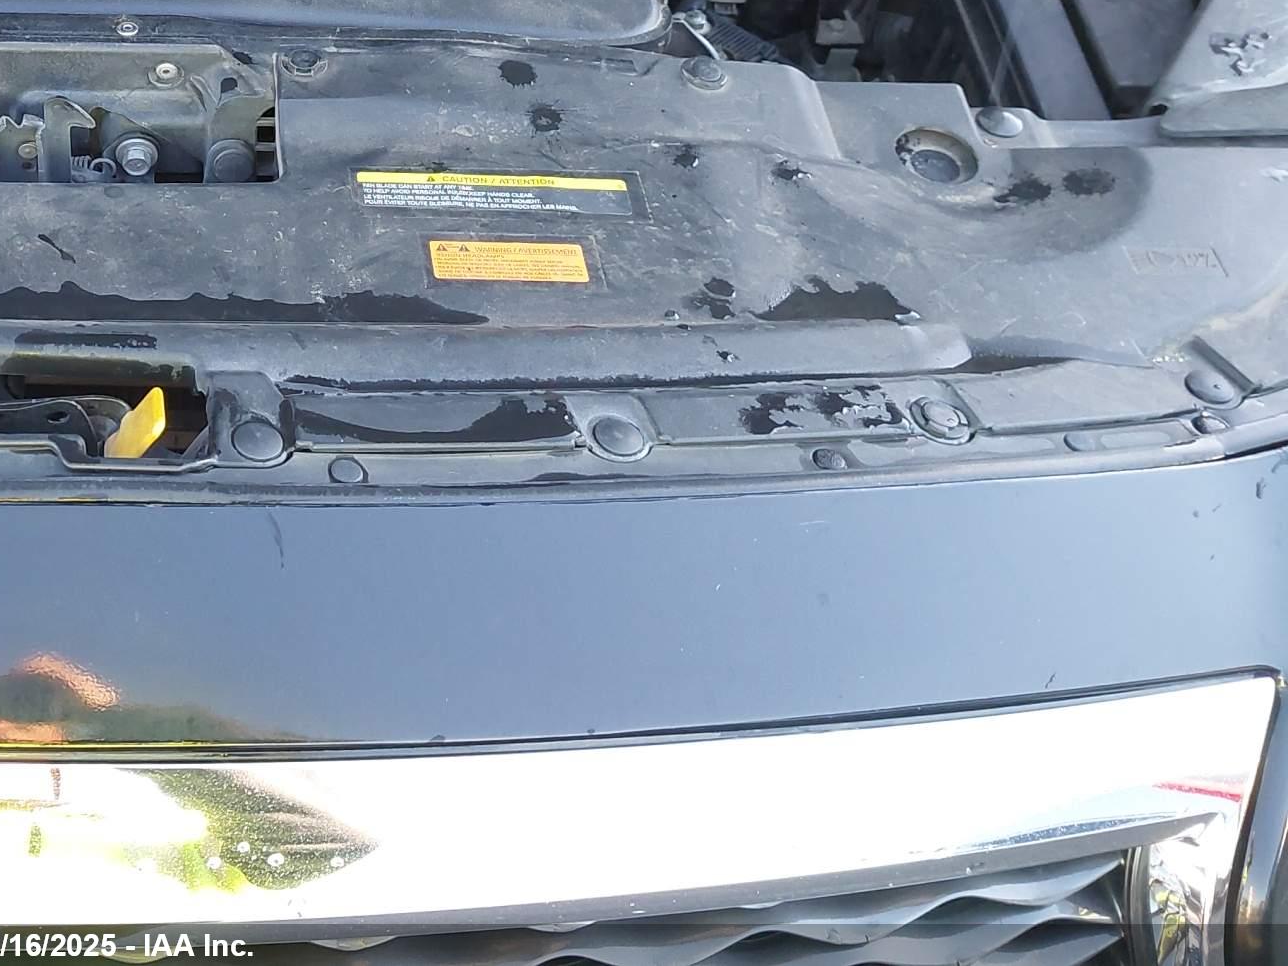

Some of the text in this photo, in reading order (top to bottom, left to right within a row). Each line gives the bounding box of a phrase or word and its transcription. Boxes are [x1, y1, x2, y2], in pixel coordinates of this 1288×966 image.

[442, 175, 488, 184] CAUTION
[499, 177, 555, 186] ATTENTION
[474, 246, 512, 254] WARNING
[518, 247, 578, 256] AVERTISSEMENT
